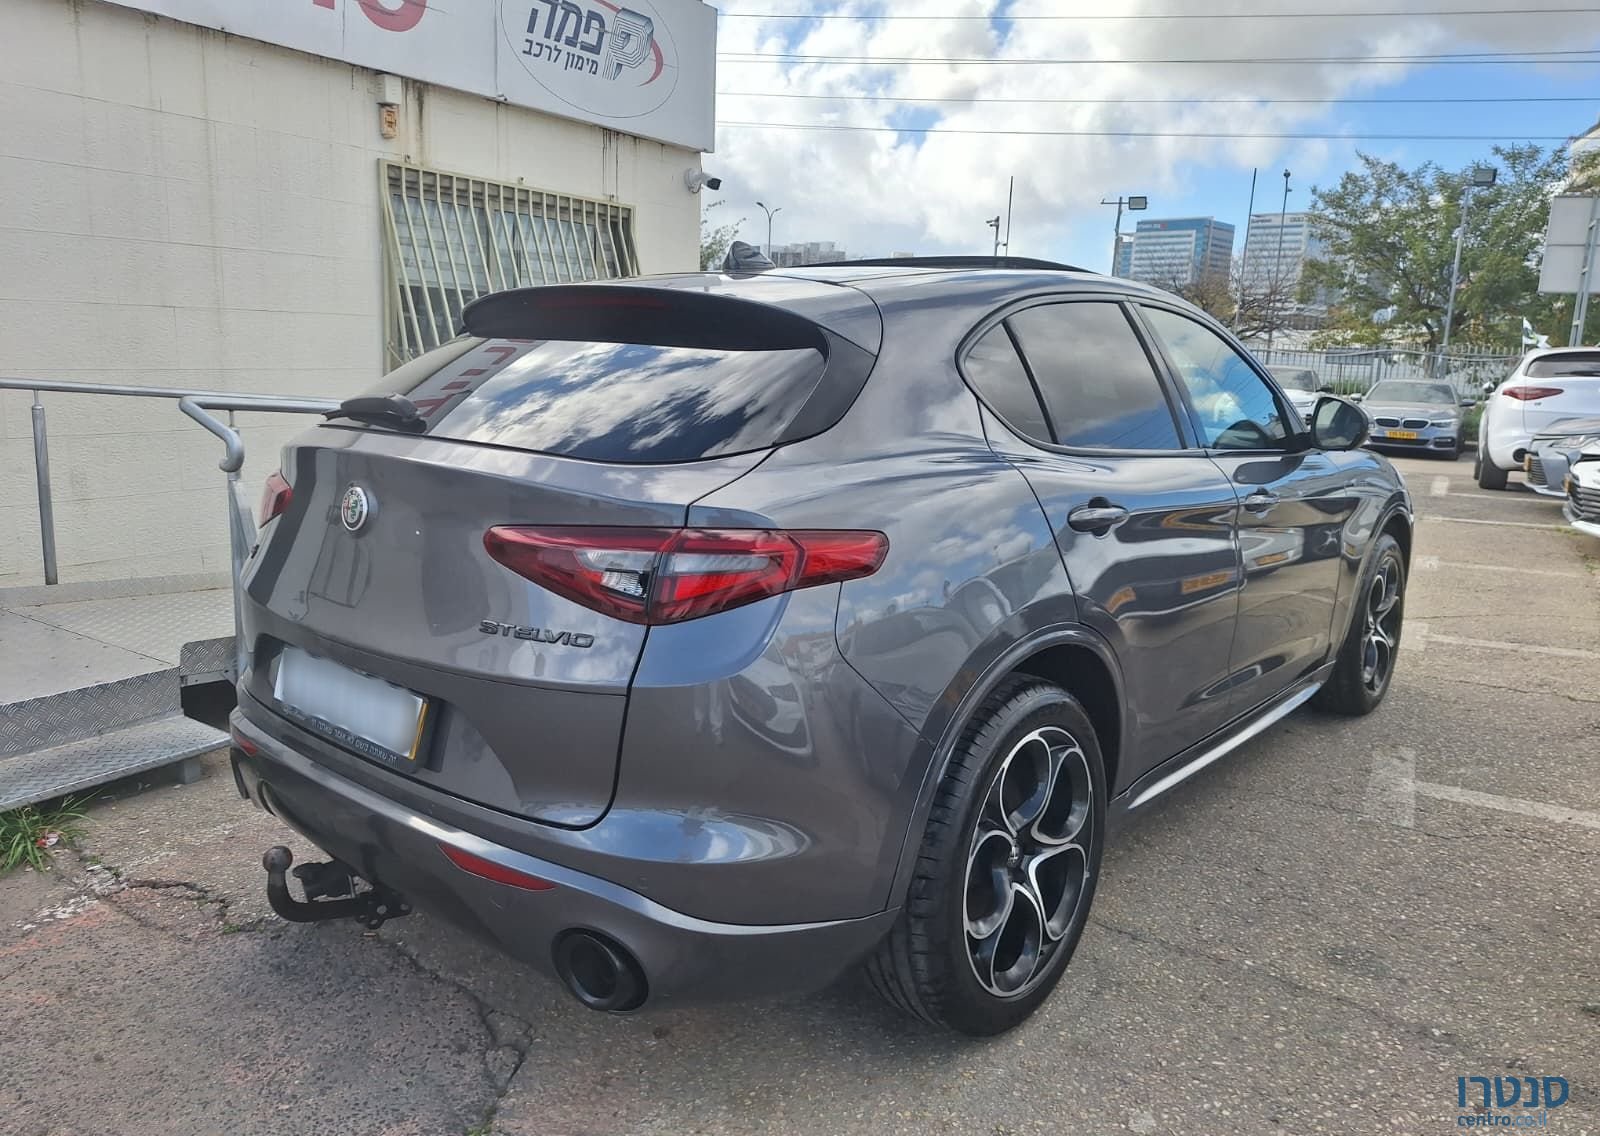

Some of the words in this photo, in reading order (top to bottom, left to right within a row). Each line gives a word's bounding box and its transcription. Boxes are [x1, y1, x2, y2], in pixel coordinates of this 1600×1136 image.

[527, 0, 605, 55] פמה
[522, 38, 562, 63] לרכב
[564, 51, 599, 75] מימון
[479, 619, 595, 649] STELVIO
